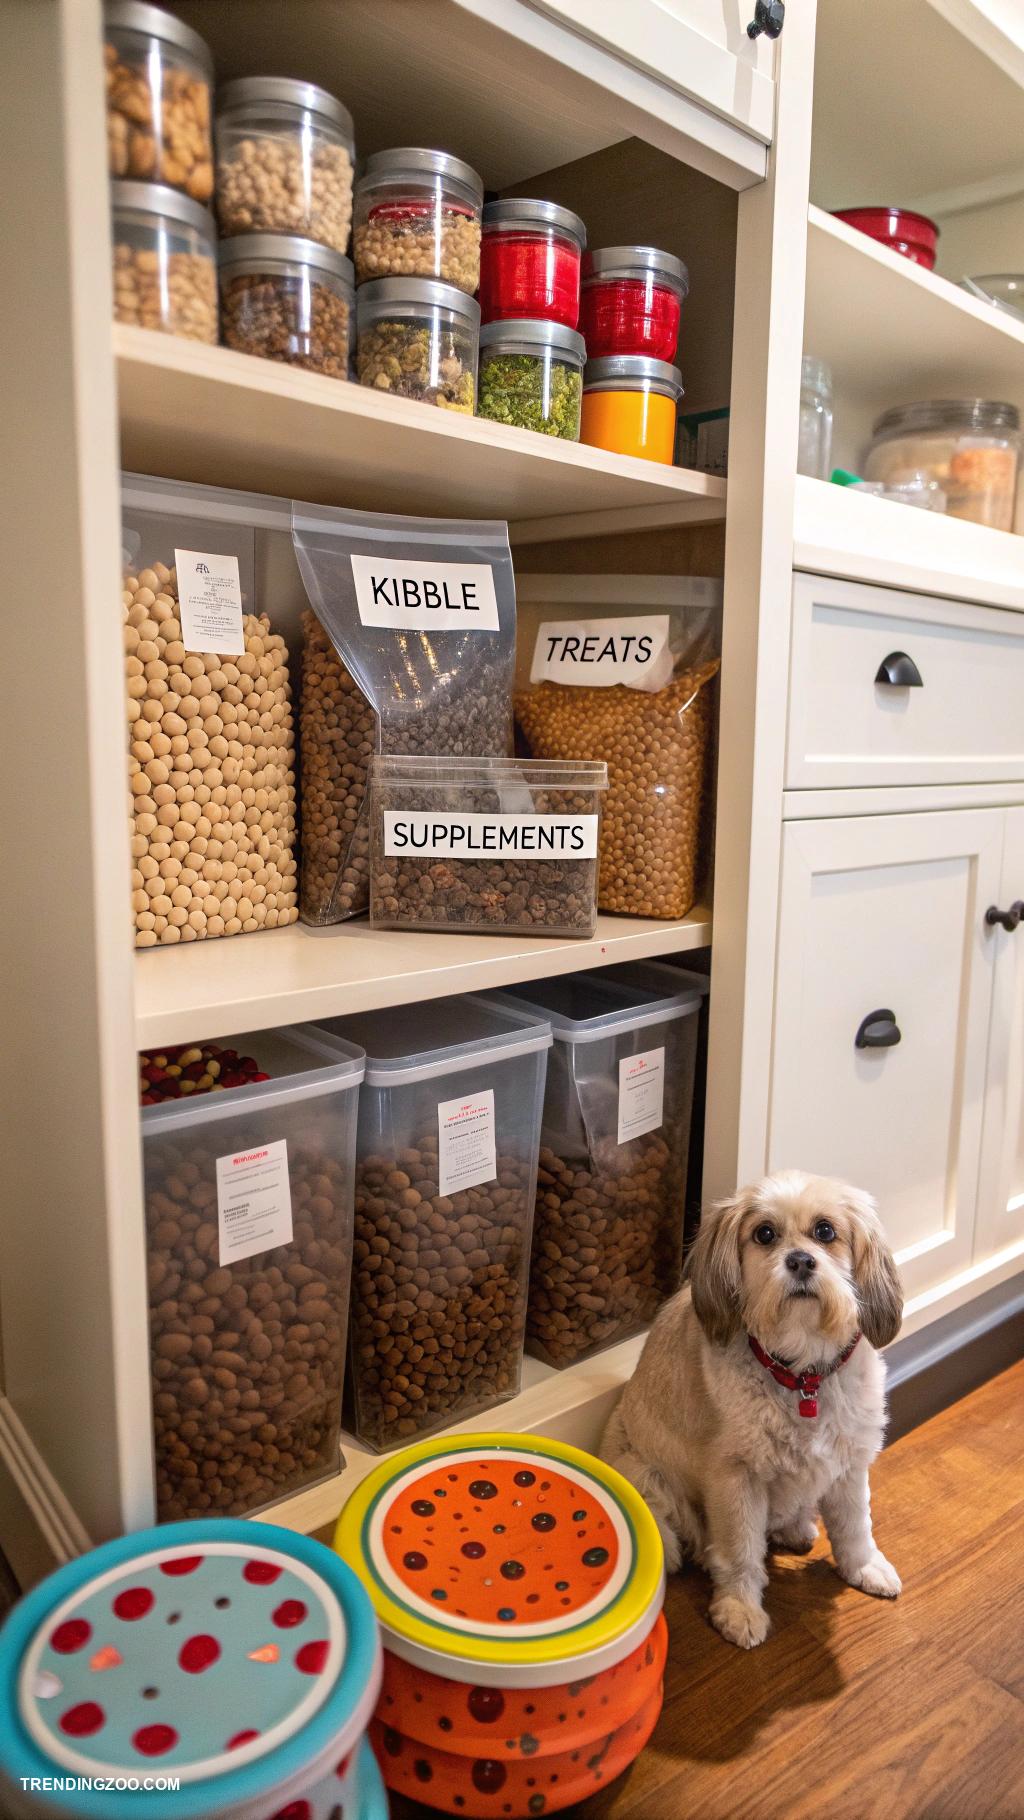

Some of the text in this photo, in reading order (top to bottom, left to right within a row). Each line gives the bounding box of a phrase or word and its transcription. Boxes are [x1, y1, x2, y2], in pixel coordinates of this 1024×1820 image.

[370, 576, 480, 611] KIBBLE
[546, 636, 653, 663] TREATS
[393, 822, 584, 850] SUPPLEMENTS
